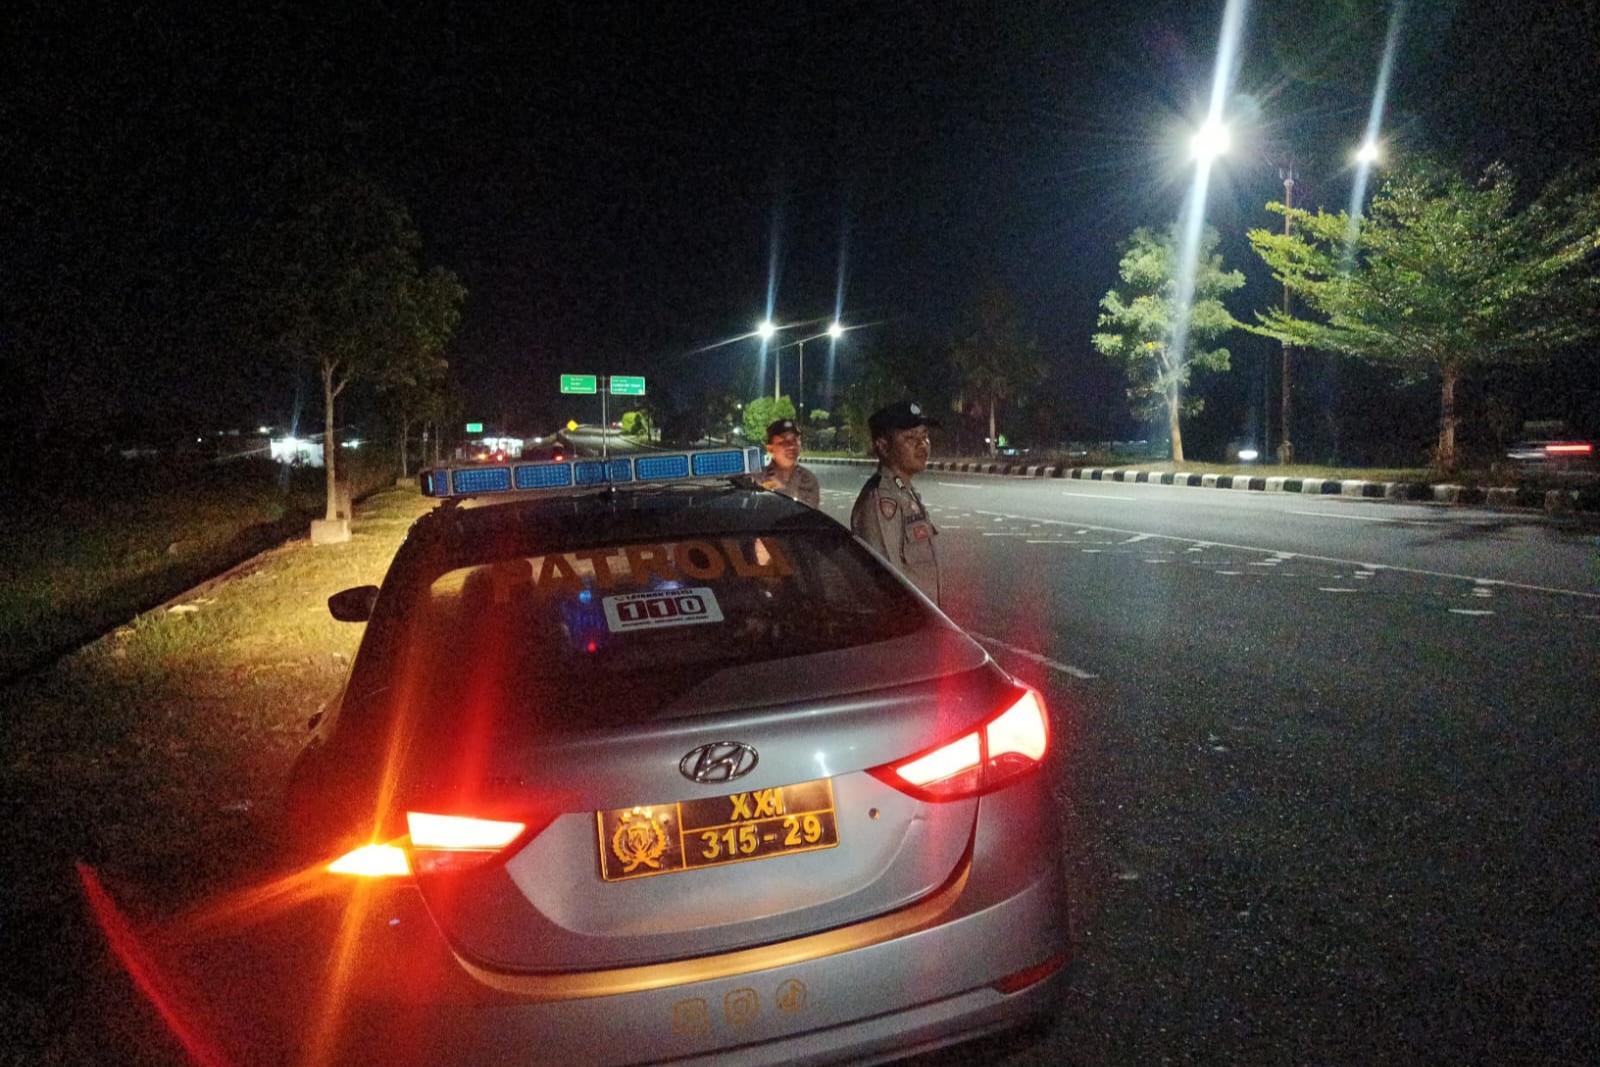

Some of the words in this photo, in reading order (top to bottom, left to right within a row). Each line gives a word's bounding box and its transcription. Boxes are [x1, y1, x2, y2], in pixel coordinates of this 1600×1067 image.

[492, 537, 794, 602] PATROLI
[620, 597, 704, 620] 110
[729, 787, 784, 821] XXI
